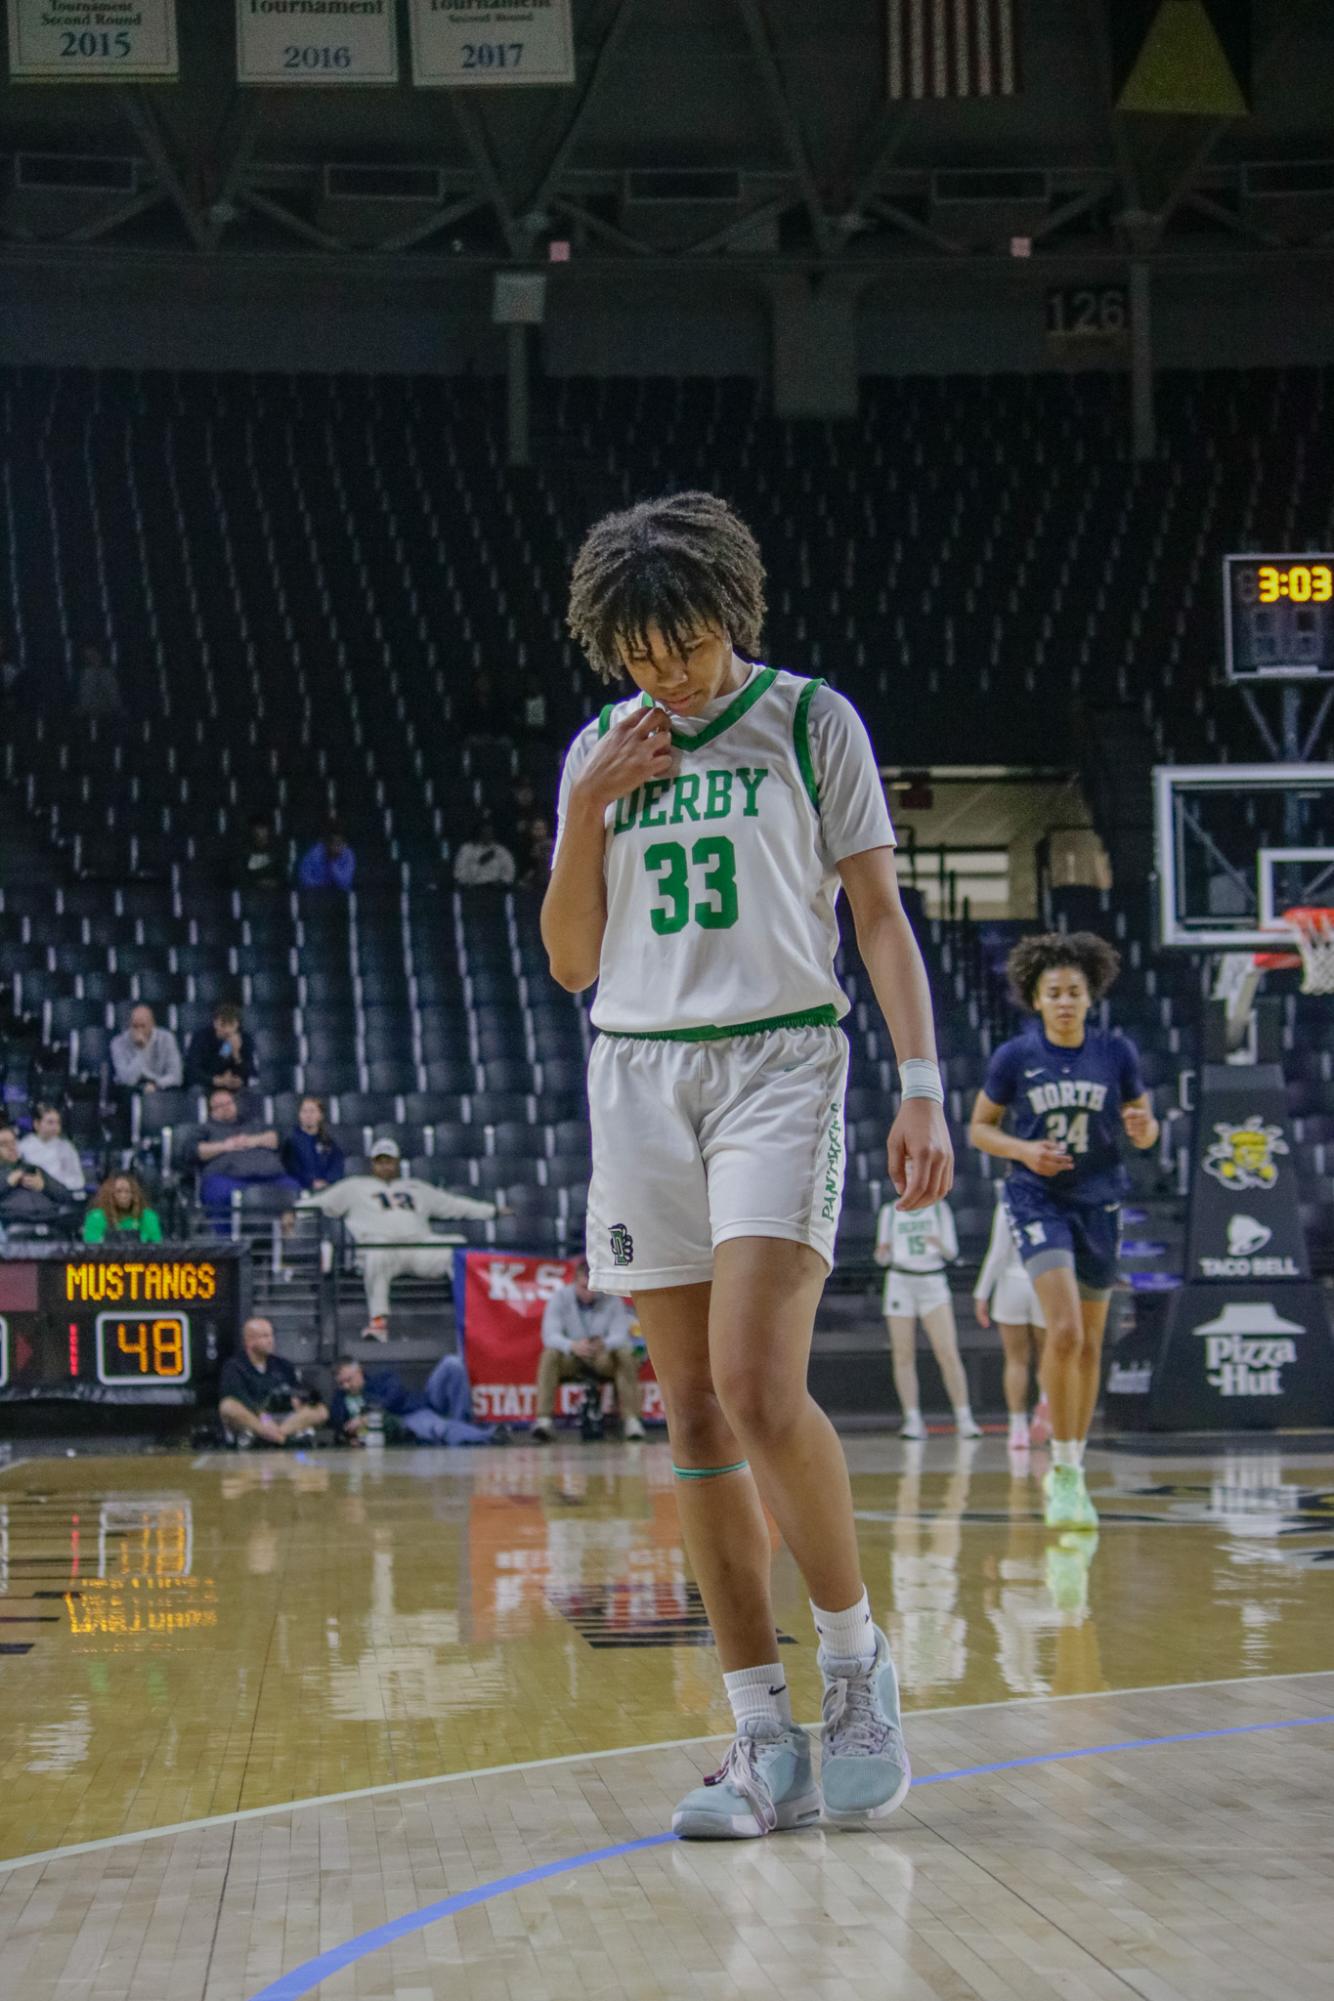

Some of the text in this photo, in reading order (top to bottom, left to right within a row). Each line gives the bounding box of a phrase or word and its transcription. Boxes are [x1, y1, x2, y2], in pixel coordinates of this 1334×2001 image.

[41, 12, 91, 26] Second
[60, 31, 131, 58] 2015
[284, 46, 351, 69] 2016
[461, 43, 524, 69] 2017
[1049, 291, 1125, 331] 126
[1258, 565, 1333, 603] 3:03
[613, 767, 769, 836] DERBY
[643, 835, 739, 936] 33
[1026, 1080, 1108, 1115] NORTH
[1046, 1112, 1090, 1154] 24
[66, 1263, 216, 1301] MUSTANGS
[1199, 1257, 1299, 1276] TACO BELL
[116, 1319, 184, 1377] 48
[1205, 1335, 1298, 1370] Pizza
[1206, 1363, 1285, 1396] Hut
[472, 1384, 540, 1417] STAT
